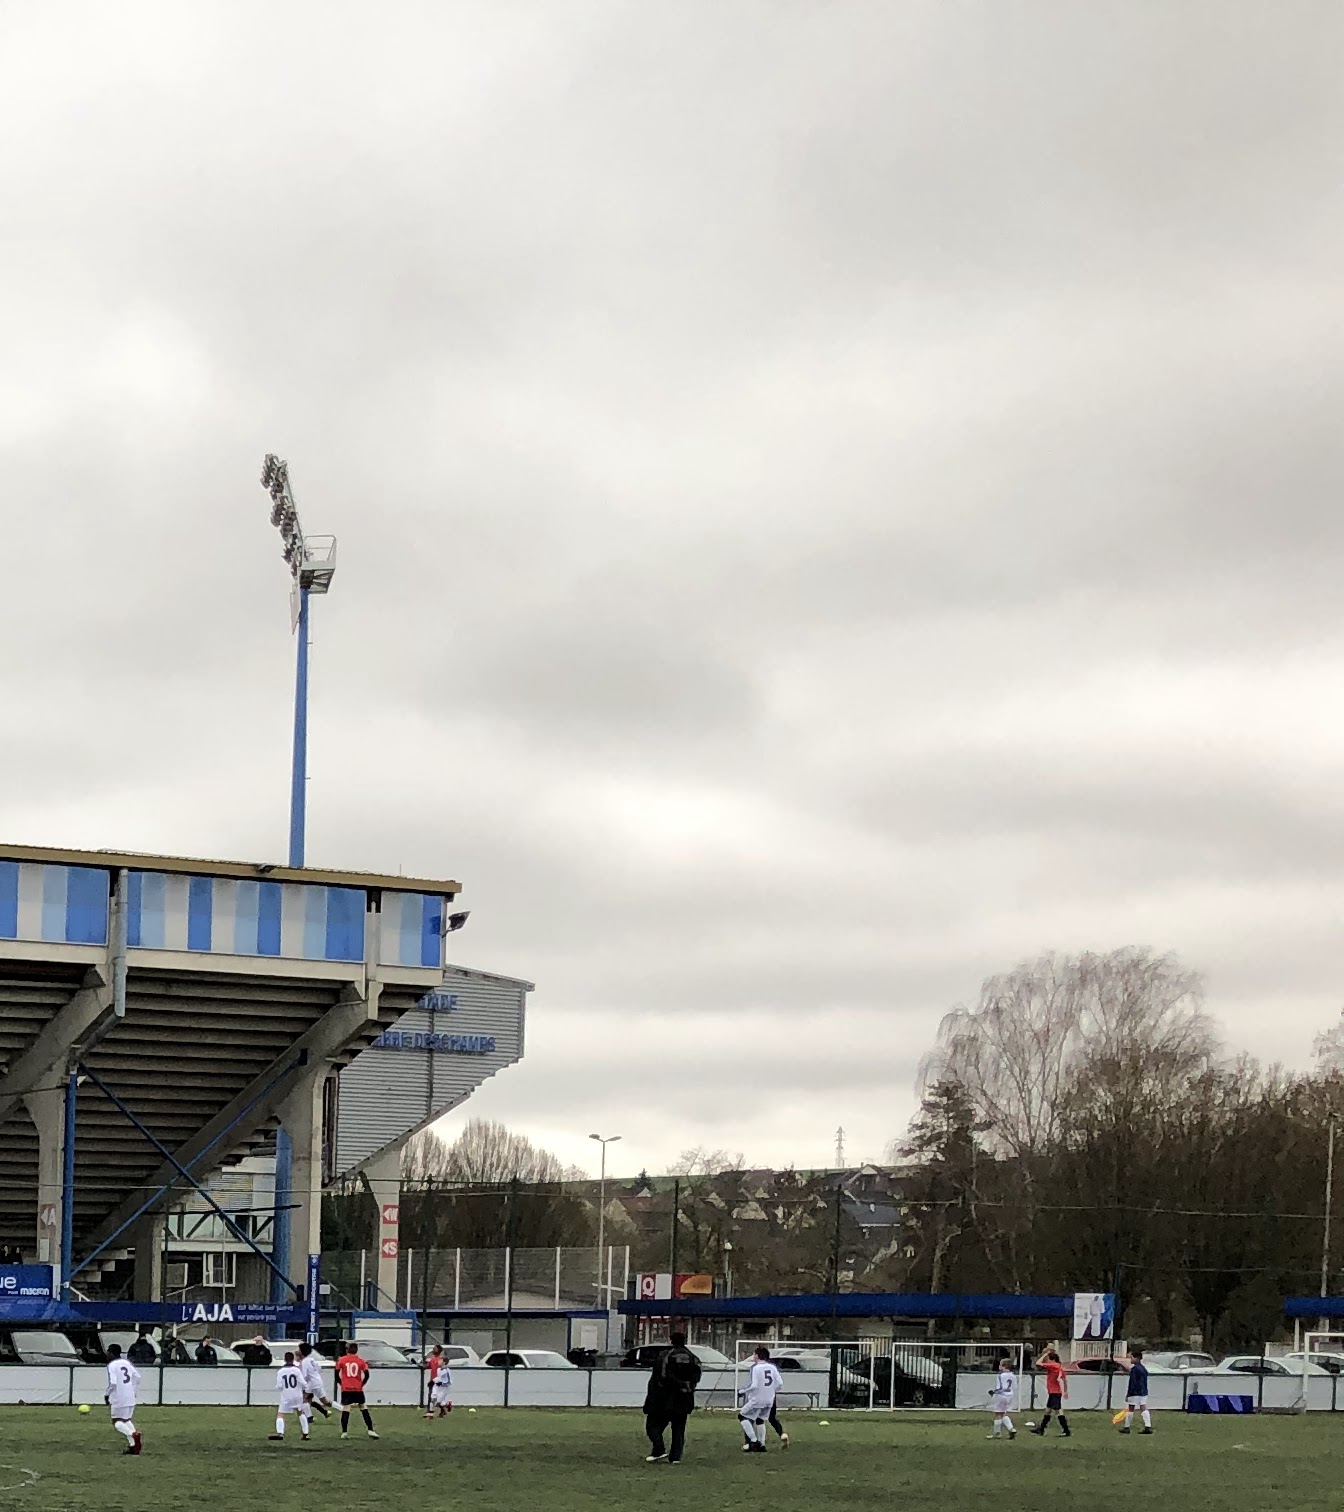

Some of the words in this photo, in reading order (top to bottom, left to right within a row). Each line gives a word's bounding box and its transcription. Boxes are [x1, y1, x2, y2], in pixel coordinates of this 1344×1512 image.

[642, 1276, 655, 1297] Q
[120, 1366, 131, 1384] 3
[344, 1362, 359, 1378] 10
[763, 1369, 773, 1387] 5
[281, 1373, 297, 1389] 10
